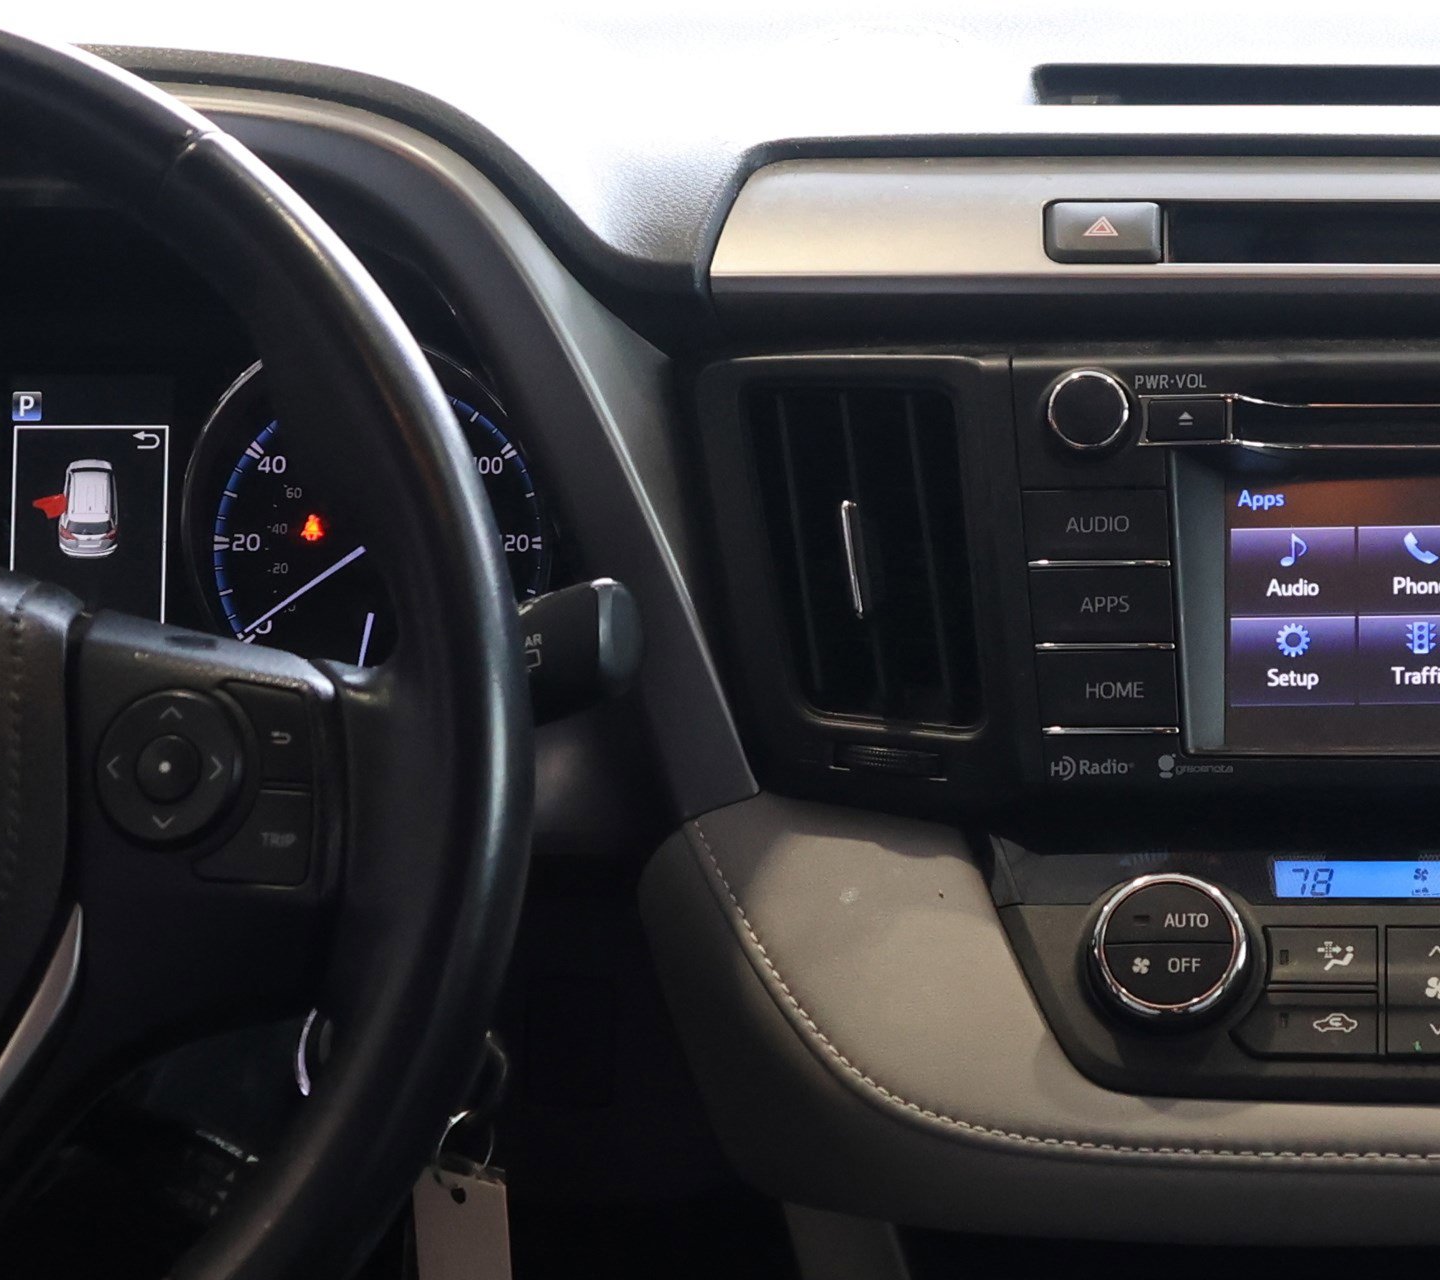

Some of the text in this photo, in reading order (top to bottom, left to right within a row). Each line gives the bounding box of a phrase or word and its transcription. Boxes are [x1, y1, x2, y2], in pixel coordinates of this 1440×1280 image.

[19, 396, 35, 416] P
[257, 456, 287, 474] 40
[286, 488, 303, 500] 60
[1237, 489, 1285, 510] Apps
[272, 523, 288, 535] 40
[1065, 515, 1130, 534] AUDIO
[232, 534, 262, 552] 20
[500, 534, 529, 552] 20
[273, 563, 289, 575] 20
[1266, 579, 1320, 597] Audio
[1080, 596, 1130, 613] APPS
[1267, 669, 1319, 690] Setup
[1085, 681, 1144, 699] HOME
[1079, 760, 1129, 775] Radio
[261, 832, 297, 847] TRIP
[1292, 868, 1334, 896] 78
[1164, 913, 1209, 928] AUTO
[1168, 958, 1201, 973] OFF
